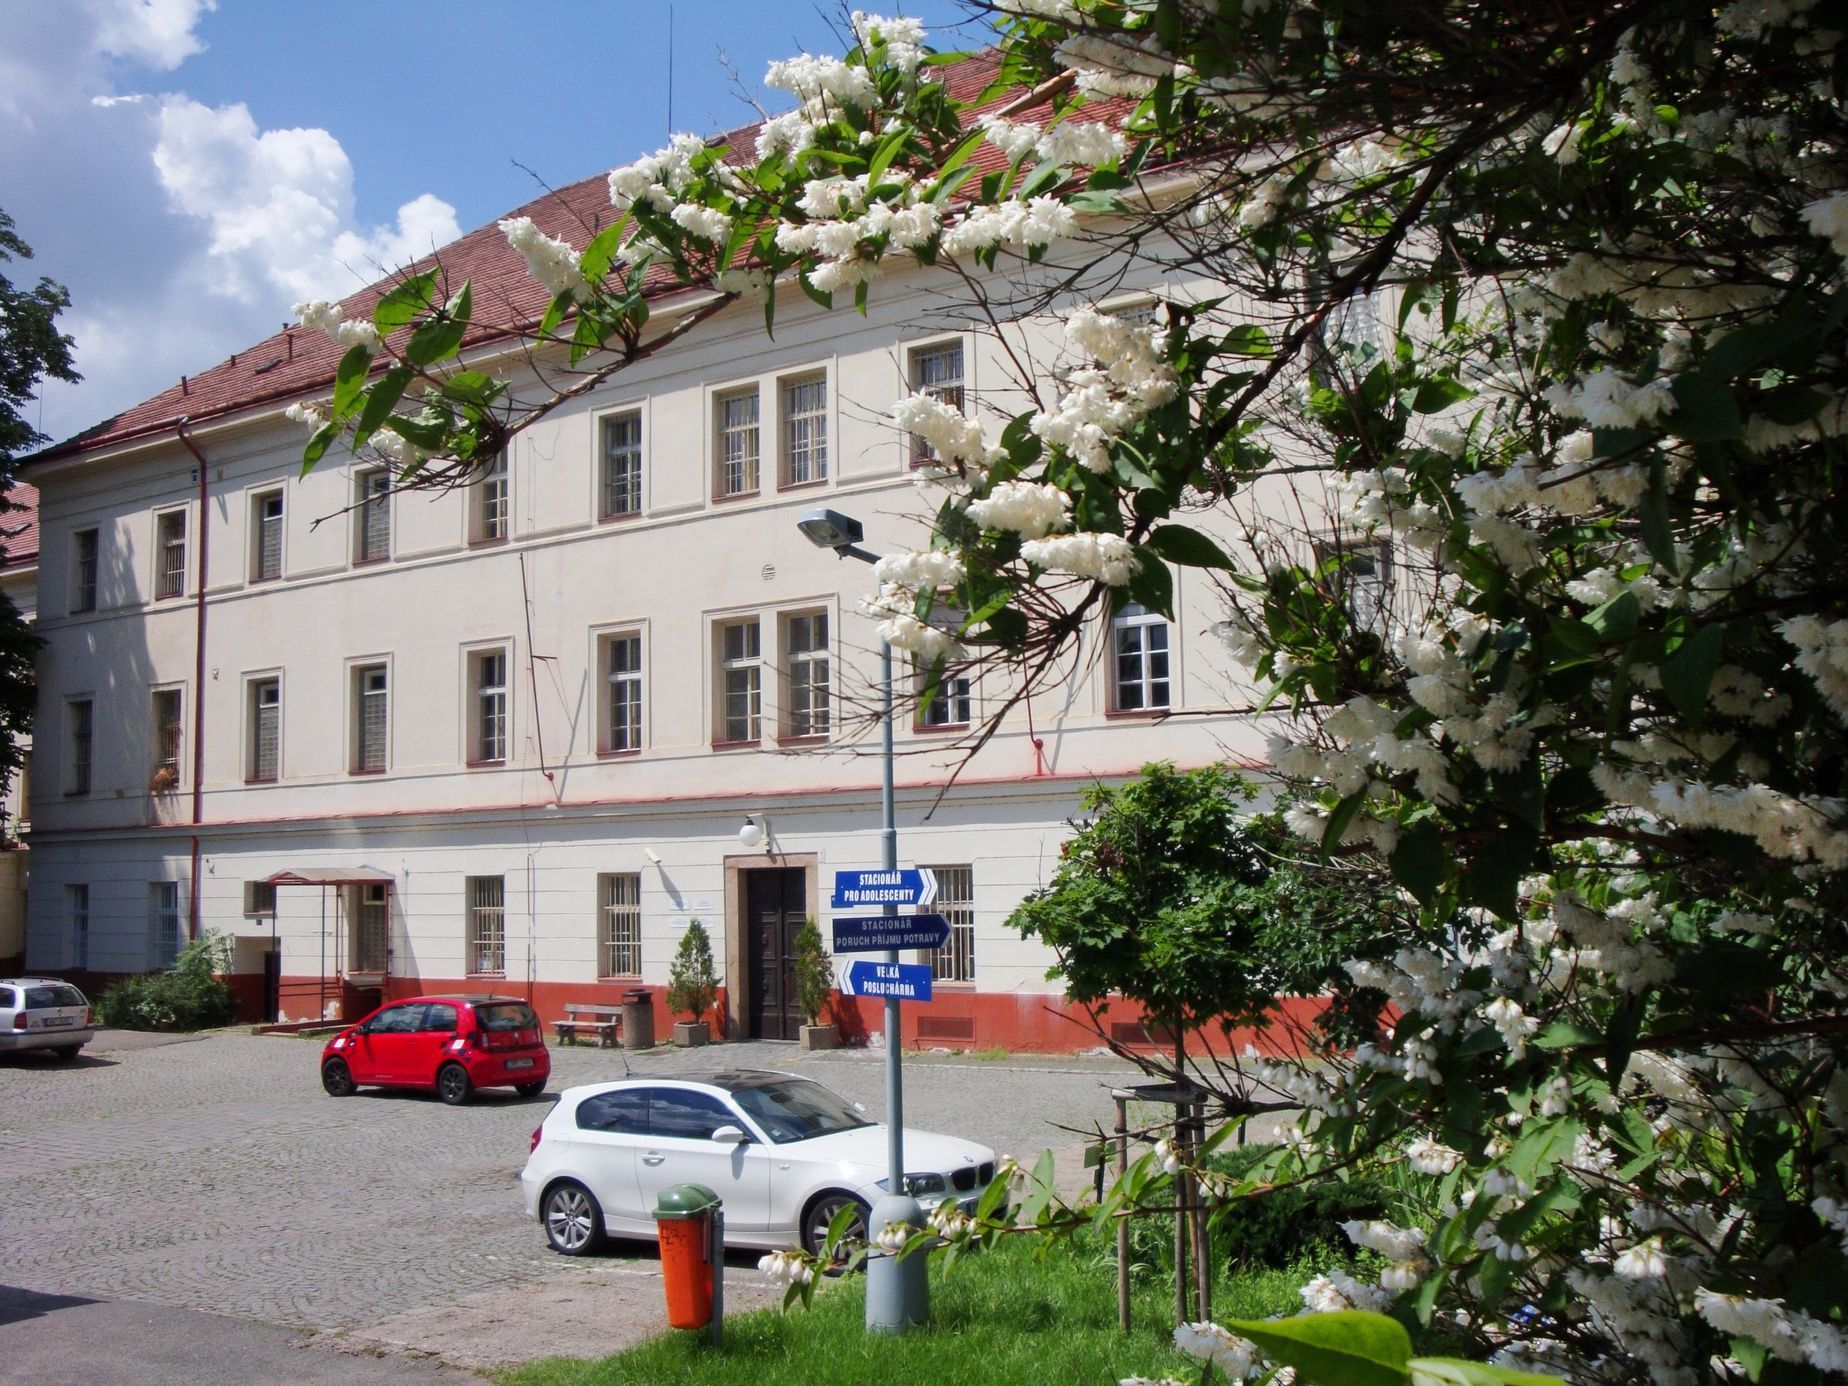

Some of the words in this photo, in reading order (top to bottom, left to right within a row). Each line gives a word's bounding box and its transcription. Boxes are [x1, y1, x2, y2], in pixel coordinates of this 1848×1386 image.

[859, 871, 902, 886] STACIONÁŘ
[844, 890, 859, 902] PRO
[860, 889, 914, 902] ADOLESCENTY
[862, 918, 912, 930] STACIONÁŘ
[836, 937, 870, 947] PORUCH
[871, 933, 901, 946] PŘÍJMU
[903, 933, 940, 944] POTRAVY
[876, 964, 900, 979] VELKÁ
[863, 980, 915, 997] POSLUCHÁRNA
